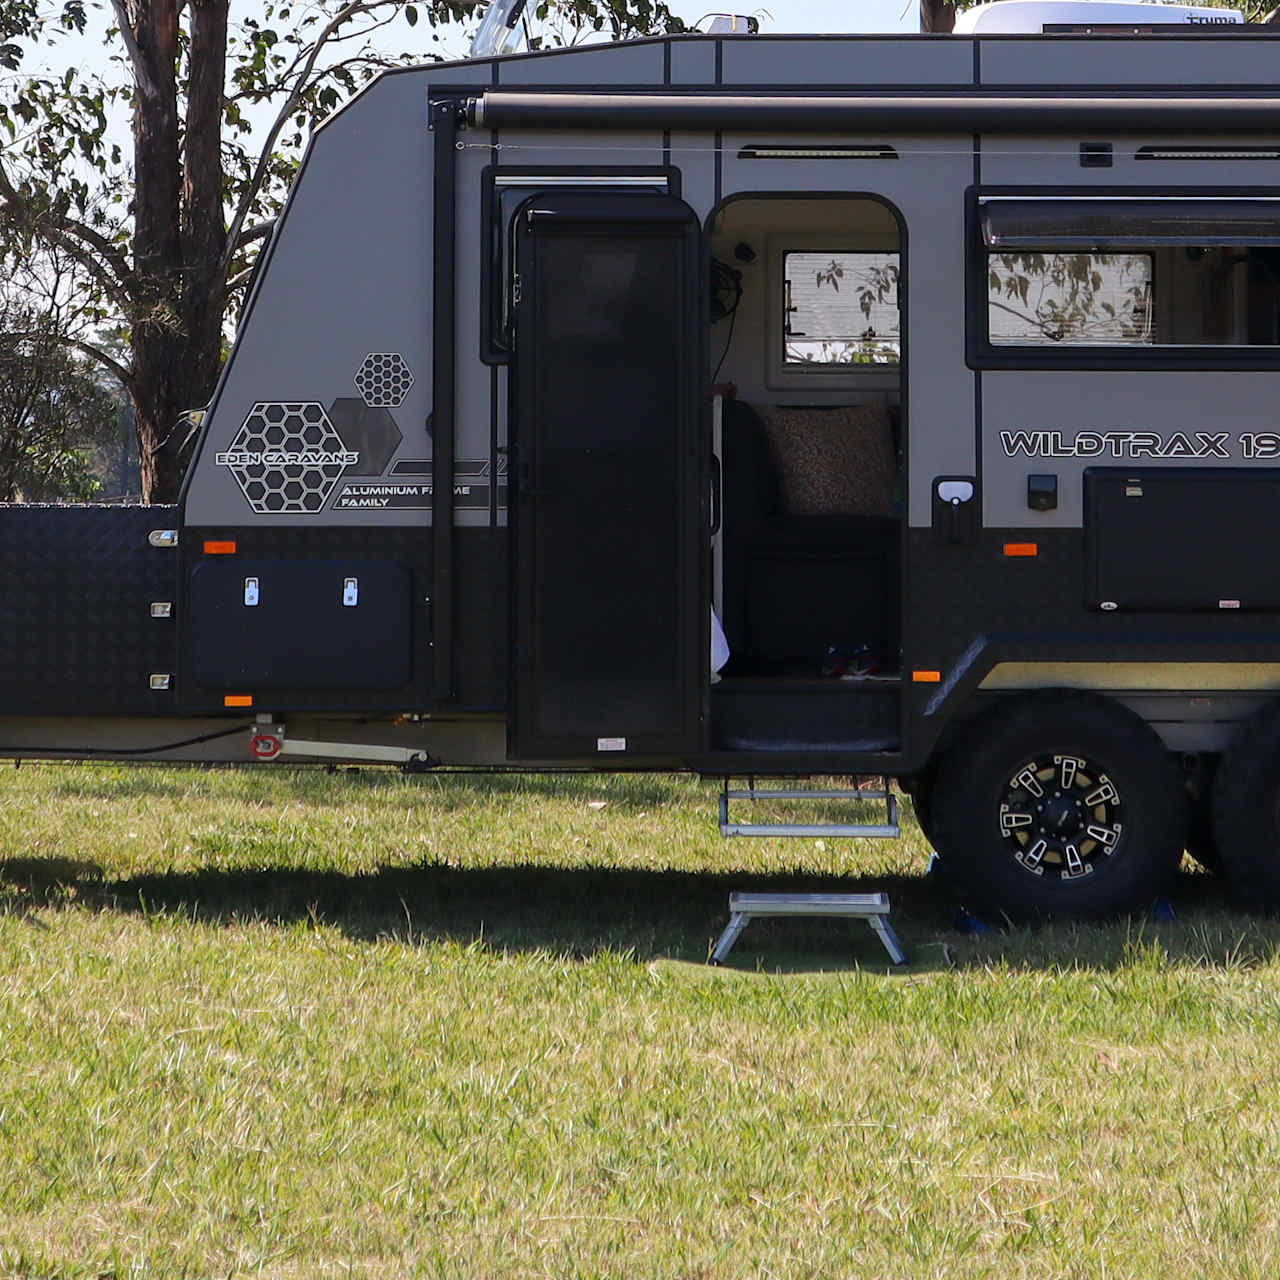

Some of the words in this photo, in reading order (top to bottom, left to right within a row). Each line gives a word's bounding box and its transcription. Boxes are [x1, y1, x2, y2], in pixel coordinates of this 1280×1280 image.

[1000, 431, 1230, 458] WILDTRAX
[216, 453, 260, 465] EDEN
[263, 452, 359, 465] CARAVANS
[341, 486, 419, 495] ALUMINIUM
[422, 486, 470, 495] FME
[341, 498, 390, 507] FAMILY
